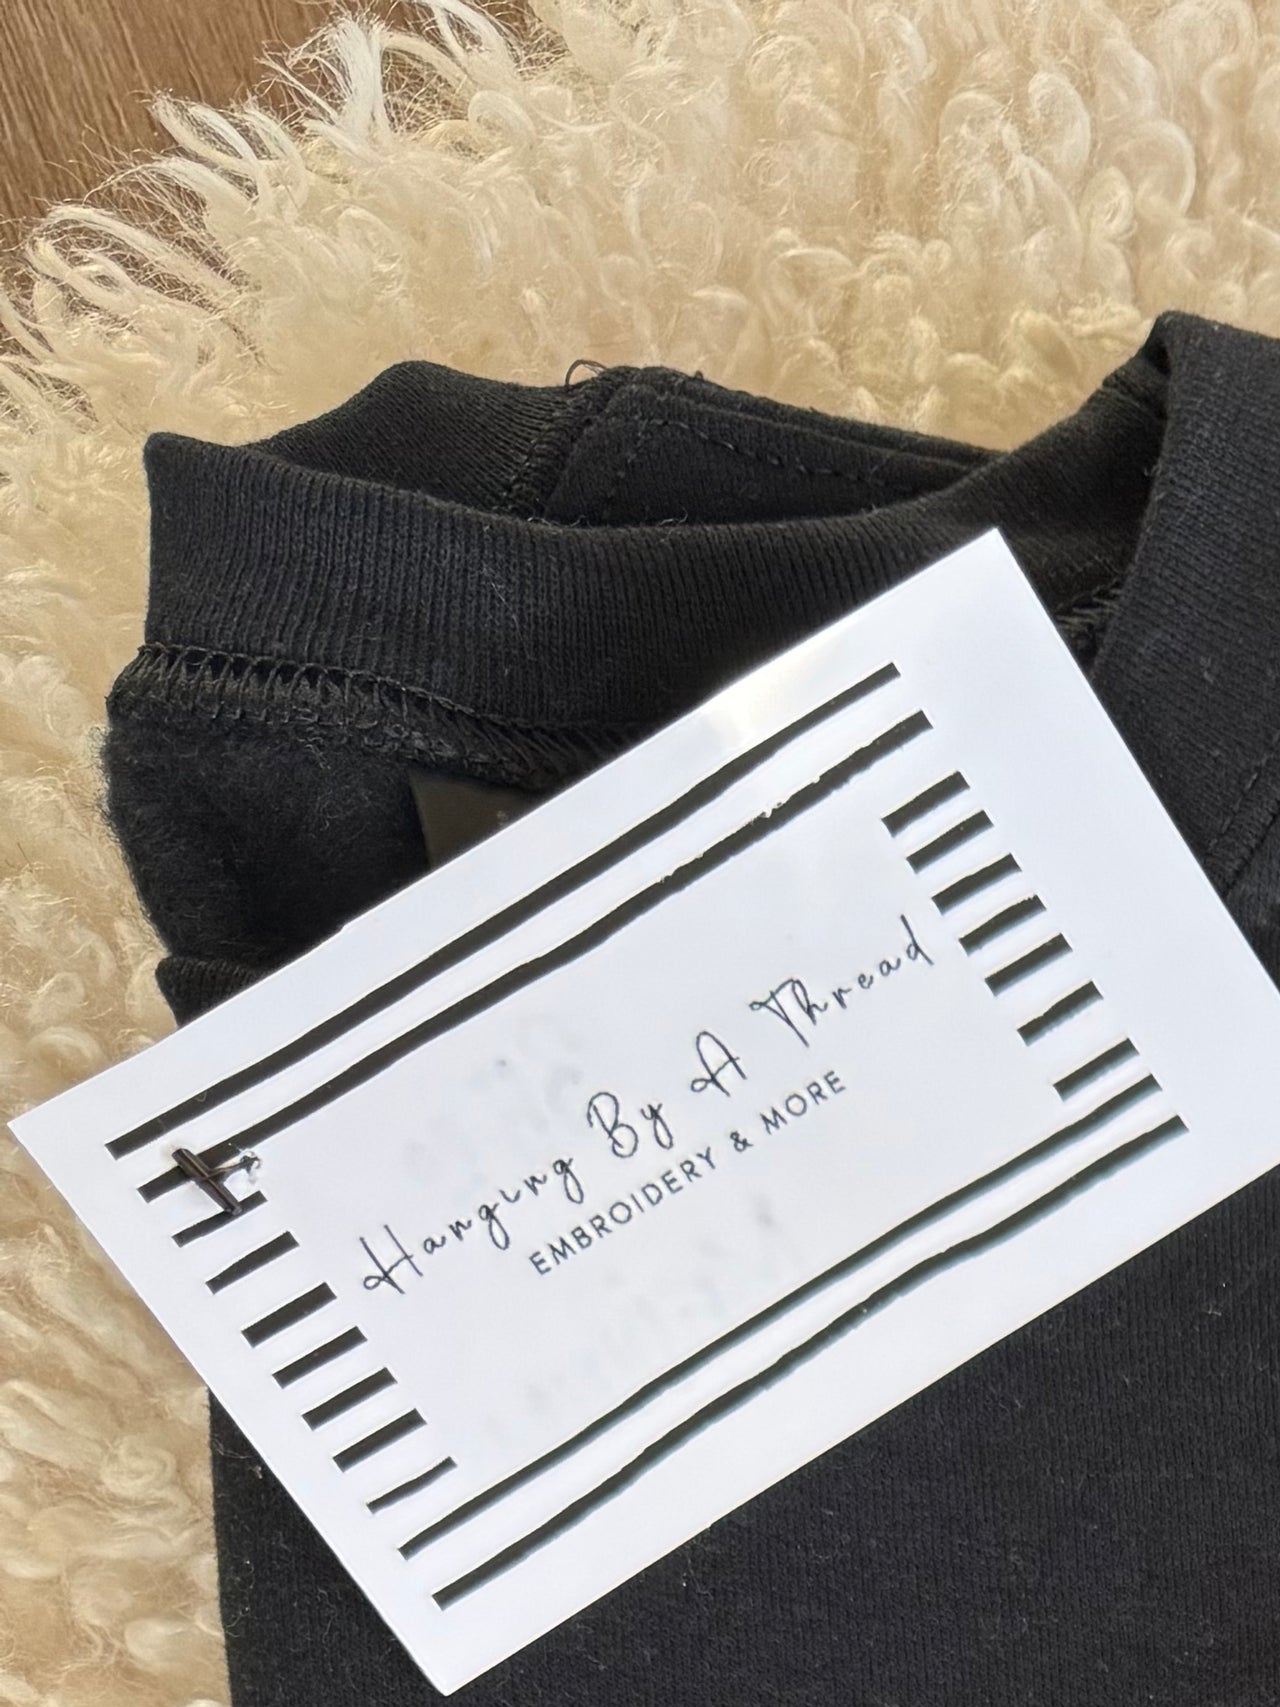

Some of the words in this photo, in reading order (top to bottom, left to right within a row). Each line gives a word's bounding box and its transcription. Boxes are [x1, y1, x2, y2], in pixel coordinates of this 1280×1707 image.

[359, 1156, 585, 1294] Hanging
[586, 1091, 674, 1159] By
[689, 1031, 748, 1097] A
[748, 914, 934, 1048] Thread
[528, 1146, 719, 1276] EMBROIDERY
[729, 1129, 754, 1153] &
[759, 1069, 847, 1137] MORE
